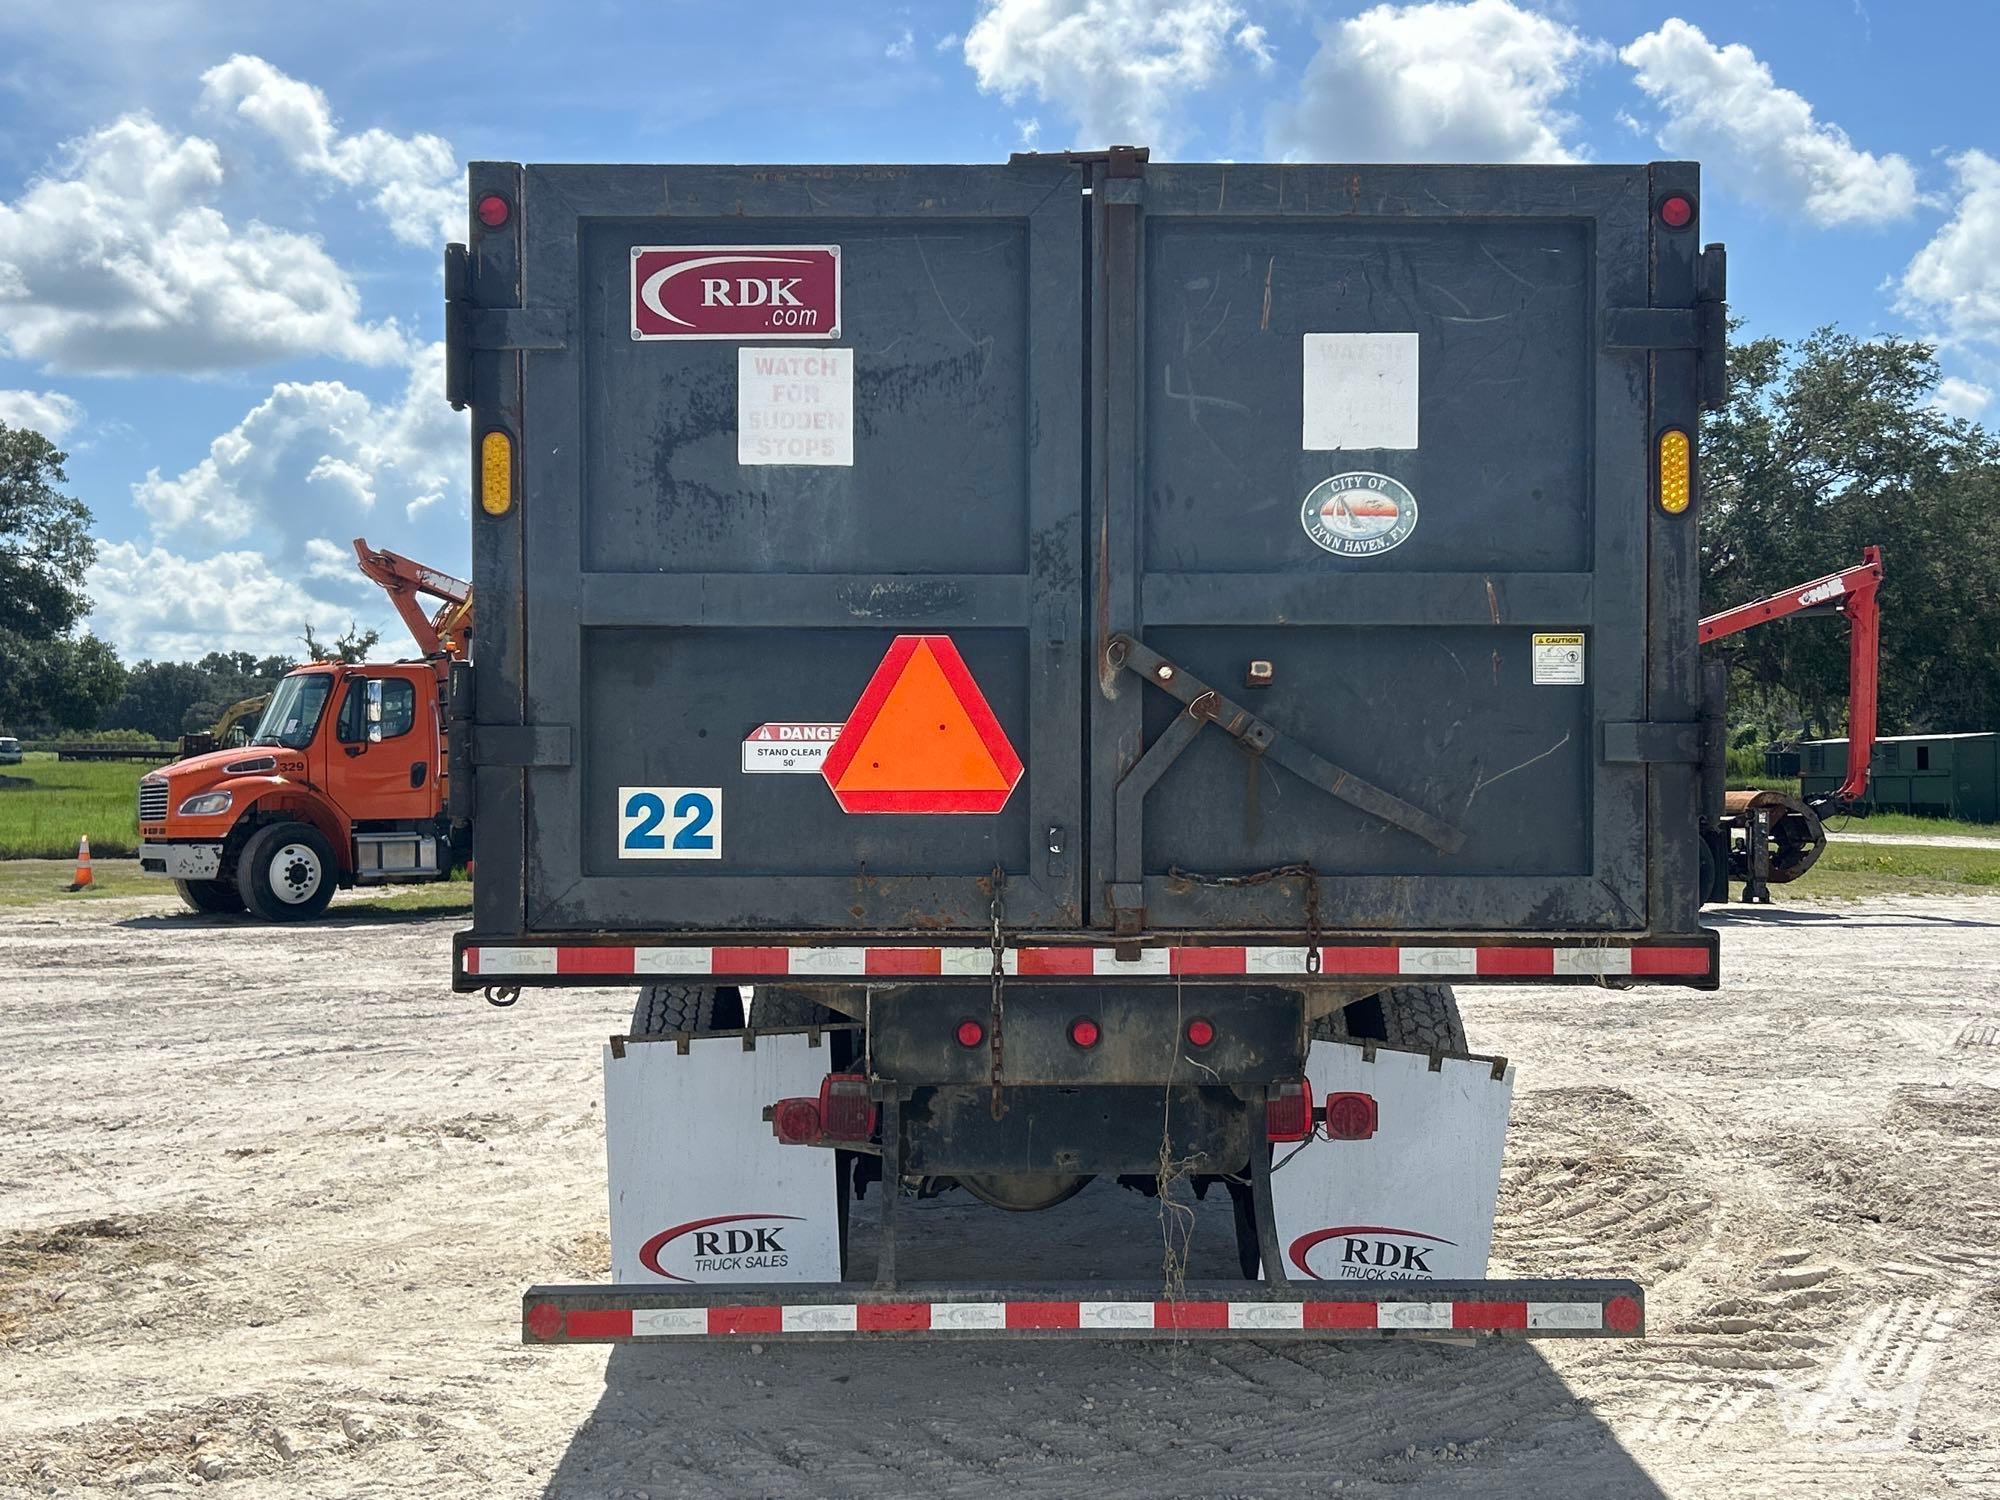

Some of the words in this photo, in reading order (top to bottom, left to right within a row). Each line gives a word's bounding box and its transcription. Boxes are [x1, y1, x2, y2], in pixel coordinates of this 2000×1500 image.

[700, 278, 804, 307] RDK
[764, 308, 818, 326] .com
[754, 357, 837, 376] WATCH
[773, 384, 820, 402] FOR
[758, 437, 835, 457] STOPS
[1331, 476, 1363, 492] CITY
[1368, 477, 1388, 490] OF
[1311, 523, 1342, 549] LYNN
[1390, 526, 1406, 541] FL
[779, 726, 842, 740] DANGE
[757, 748, 789, 756] STAND
[790, 748, 822, 756] CLEAR
[279, 762, 304, 772] 329
[624, 792, 714, 850] 22
[693, 1227, 787, 1258] RDK
[695, 1257, 741, 1272] TRUCK
[744, 1254, 789, 1268] SALES
[1341, 1237, 1434, 1273] RDK
[1341, 1265, 1387, 1280] TRUCK
